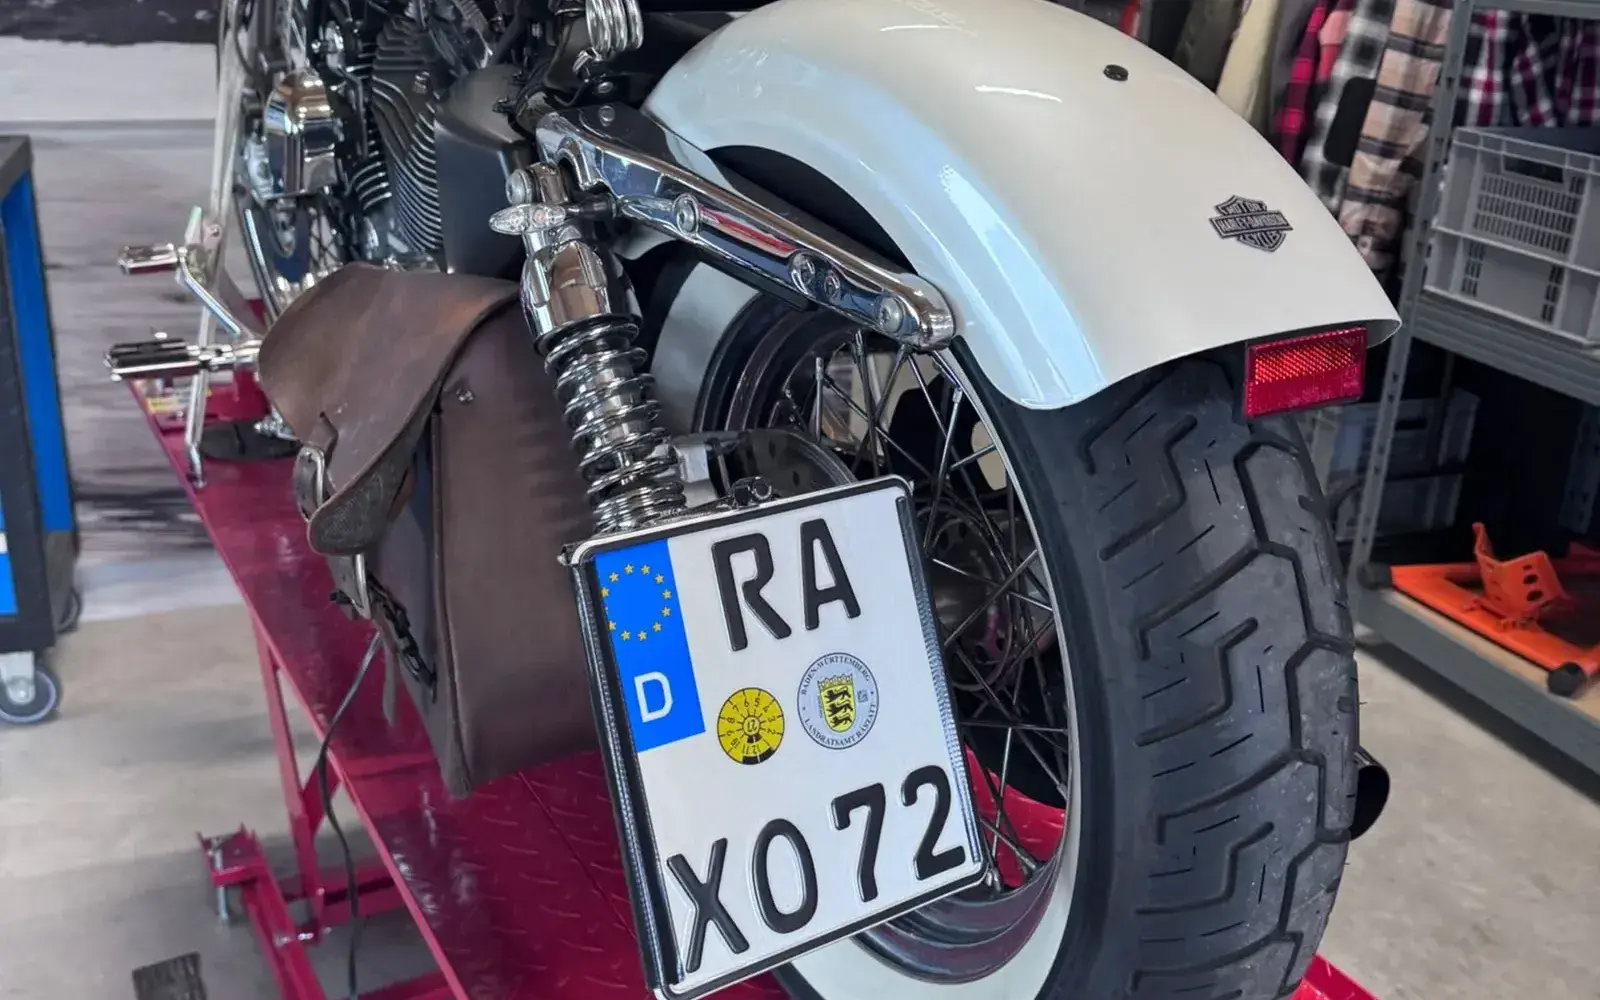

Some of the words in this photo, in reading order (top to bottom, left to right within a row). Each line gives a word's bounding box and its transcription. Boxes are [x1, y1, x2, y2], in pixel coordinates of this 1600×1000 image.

[711, 517, 862, 652] RA
[633, 670, 673, 723] D
[667, 817, 818, 974] XO
[830, 764, 967, 903] 72
